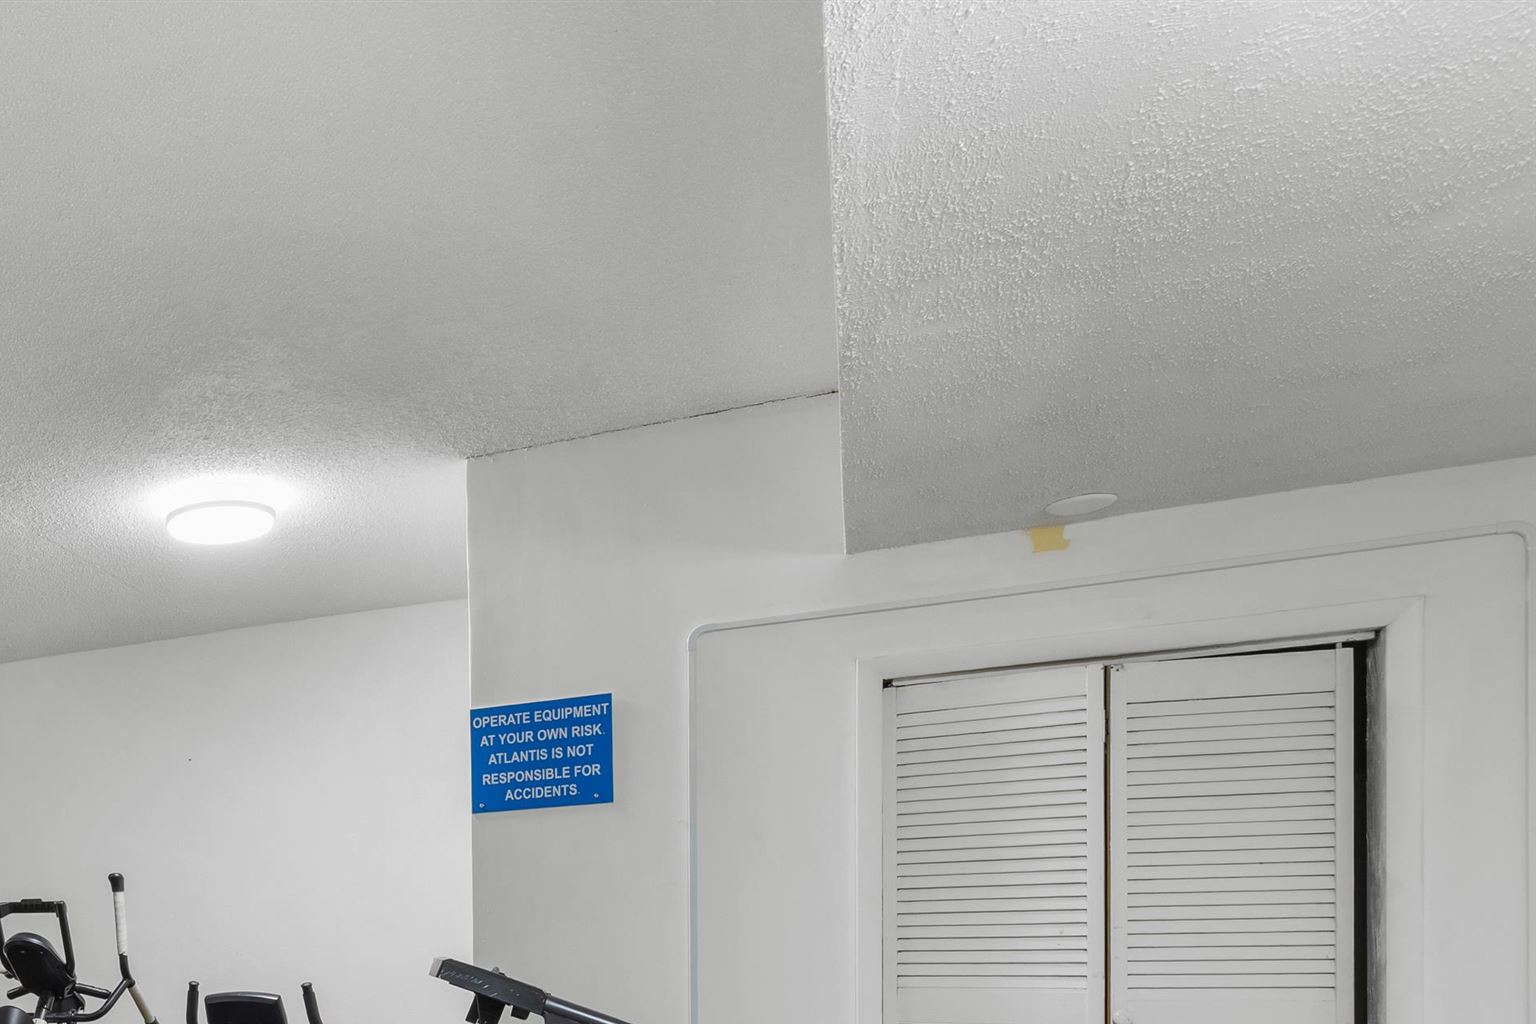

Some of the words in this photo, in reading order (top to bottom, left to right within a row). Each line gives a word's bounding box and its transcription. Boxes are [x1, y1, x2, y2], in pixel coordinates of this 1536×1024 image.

[472, 711, 531, 729] OPERATE
[534, 703, 609, 723] EQUIPMENT
[480, 734, 496, 747] AT
[498, 730, 534, 744] YOUR
[537, 727, 568, 741] OWN
[488, 748, 548, 765] ATLANTIS
[551, 746, 563, 759] IS
[566, 743, 594, 757] NOT
[482, 766, 570, 786] RESPONSIBLE
[574, 763, 601, 778] FOR
